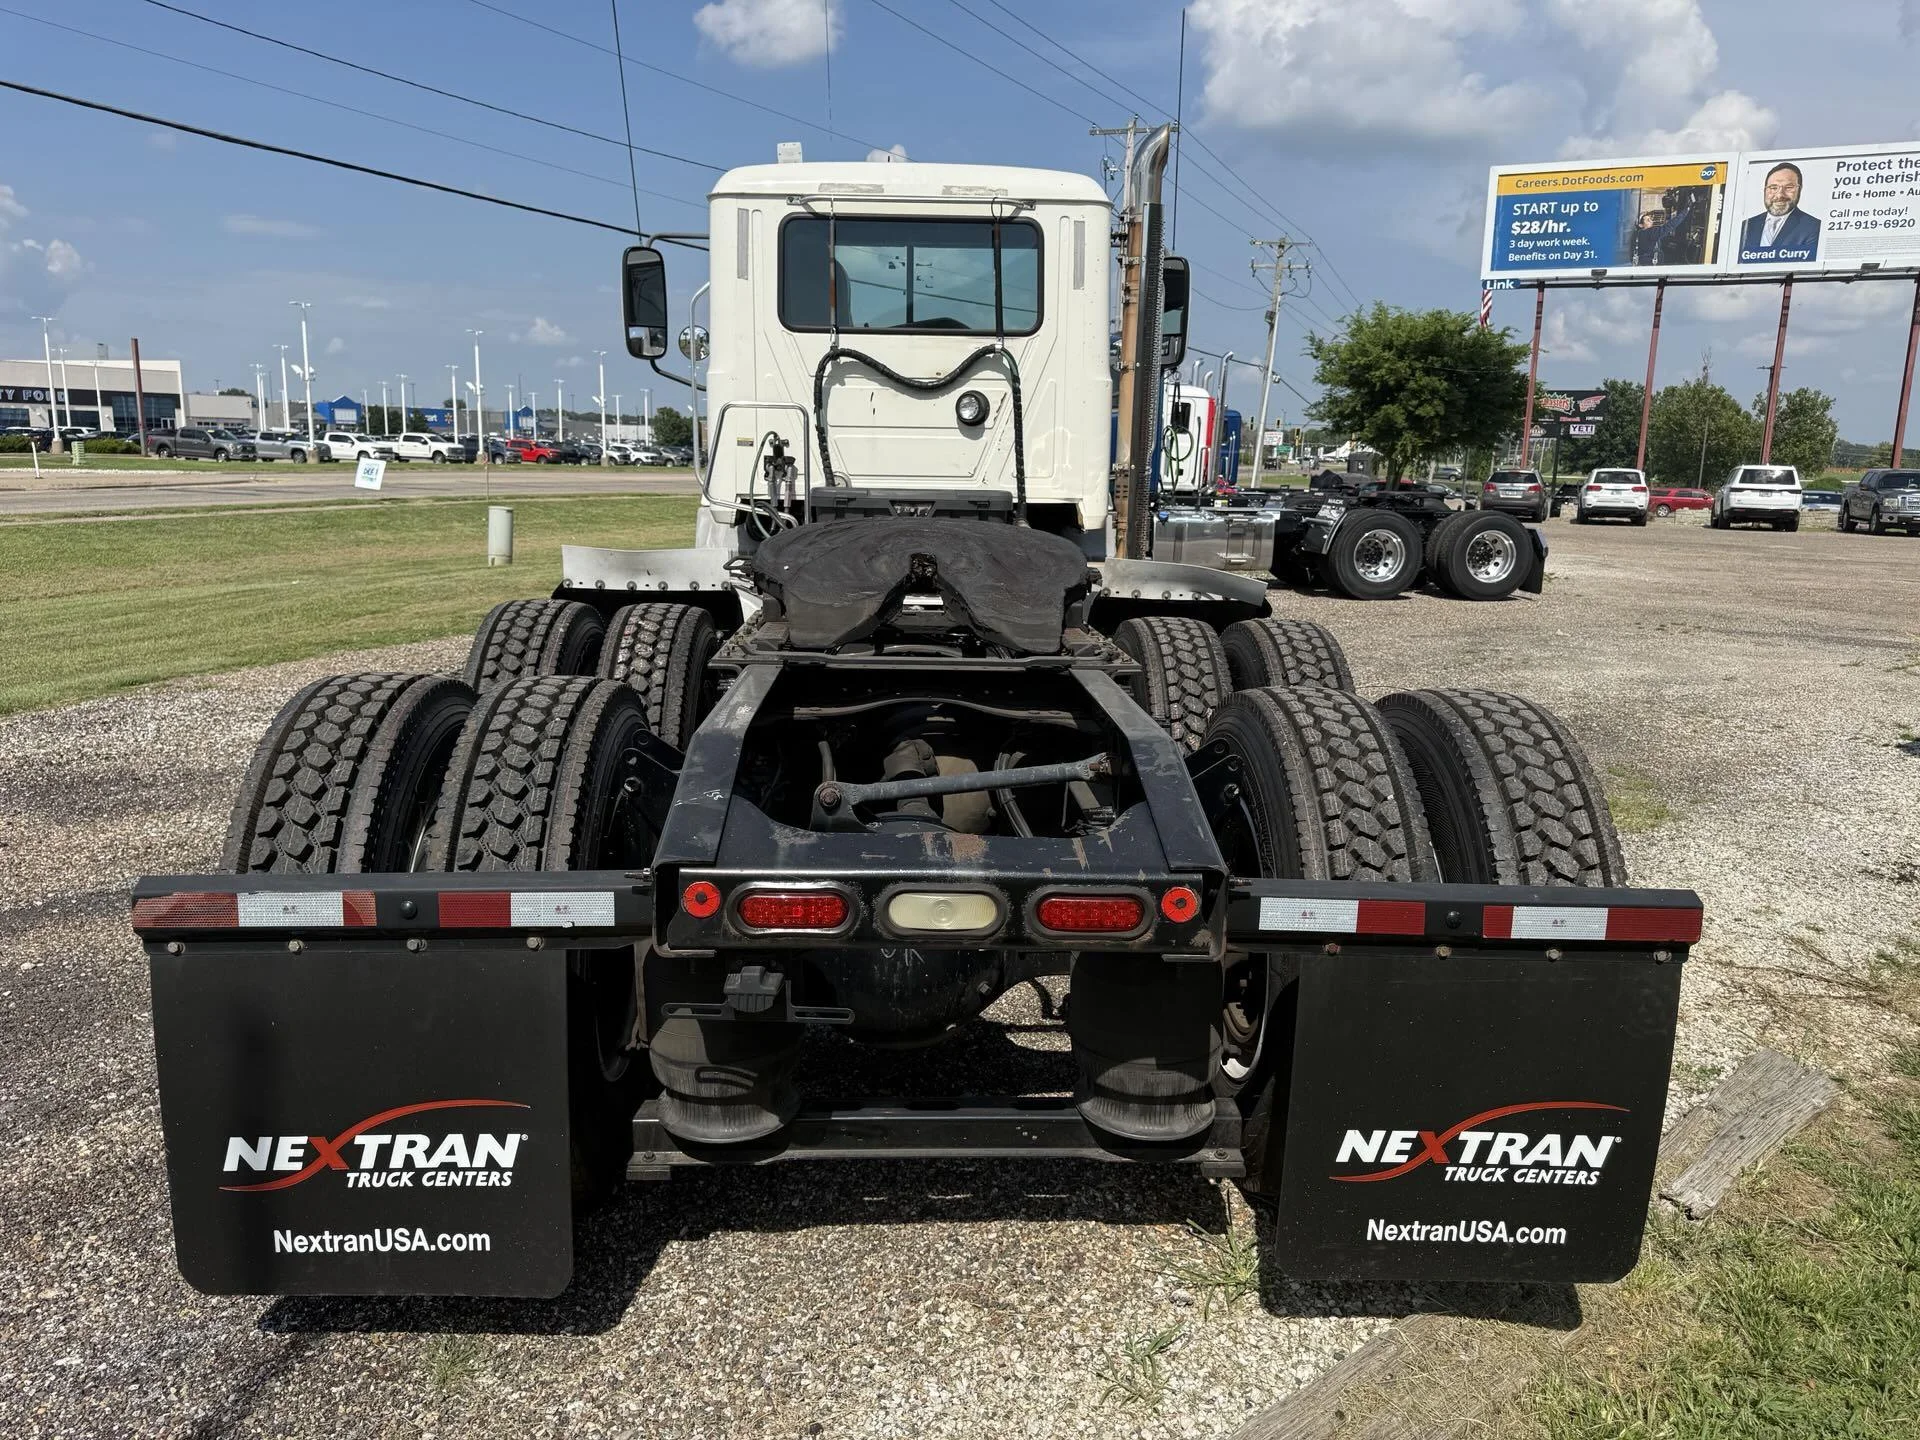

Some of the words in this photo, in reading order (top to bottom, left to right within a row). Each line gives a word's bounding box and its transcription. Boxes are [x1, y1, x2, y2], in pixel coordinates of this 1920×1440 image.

[1836, 159, 1892, 172] Protect
[1515, 173, 1644, 189] Careers.DotFoods.com
[1833, 176, 1861, 188] you
[1831, 190, 1852, 200] Life
[1863, 189, 1896, 198] Home
[1512, 202, 1557, 216] START
[1561, 204, 1579, 216] up
[1583, 201, 1599, 213] to
[1829, 209, 1850, 218] Call
[1872, 207, 1908, 217] today!
[1511, 220, 1571, 236] $28/hr.
[1828, 218, 1916, 231] 217-919-6920
[1509, 240, 1516, 248] 3
[1517, 240, 1535, 250] day
[1536, 238, 1560, 247] work
[1562, 237, 1590, 246] week.
[1508, 252, 1546, 262] Benefits
[1563, 251, 1581, 262] Day
[1583, 250, 1598, 260] 31.
[1741, 251, 1776, 260] Gerad
[1779, 249, 1811, 260] Curry
[1486, 280, 1514, 290] Link
[346, 1171, 415, 1188] TRUCK
[421, 1171, 512, 1187] CENTERS
[1444, 1166, 1508, 1183] TRUCK
[1513, 1168, 1600, 1185] CENTERS
[1366, 1218, 1567, 1244] NextranUSA.com
[273, 1227, 491, 1252] NextranUSA.com
